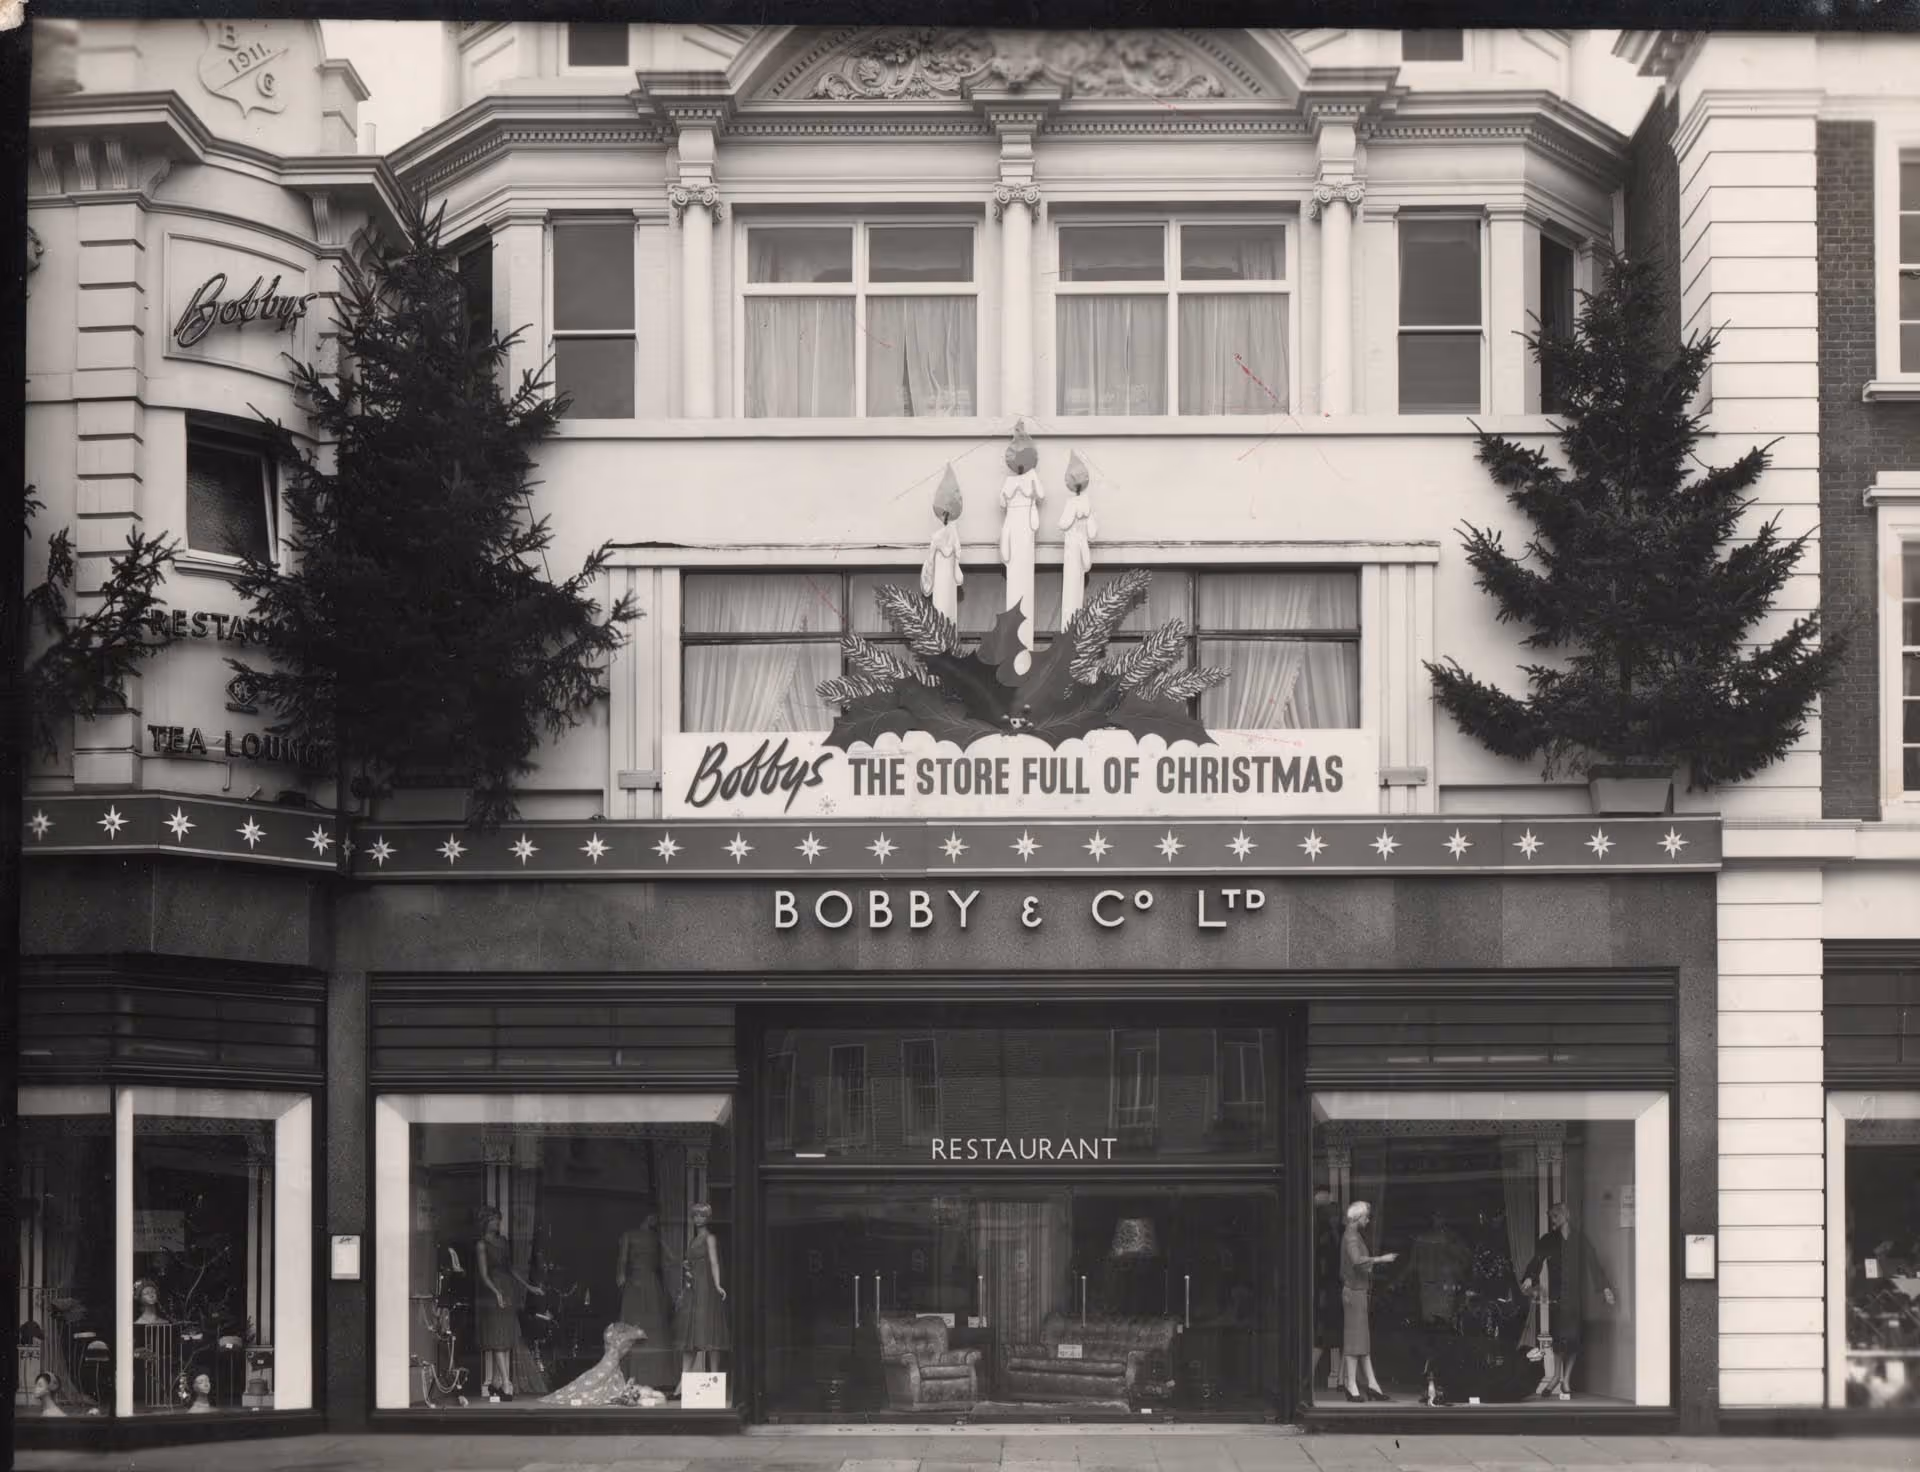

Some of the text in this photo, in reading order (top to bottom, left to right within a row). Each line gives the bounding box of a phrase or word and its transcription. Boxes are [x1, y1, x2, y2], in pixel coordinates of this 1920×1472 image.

[173, 272, 319, 348] Bobbys
[147, 724, 208, 755] TEA
[684, 737, 1344, 814] Bobbys THE STORE FULL OF CHRISTMAS
[775, 889, 981, 929] BOBBY
[1021, 895, 1043, 928] &
[932, 1138, 1118, 1160] RESTAURANT
